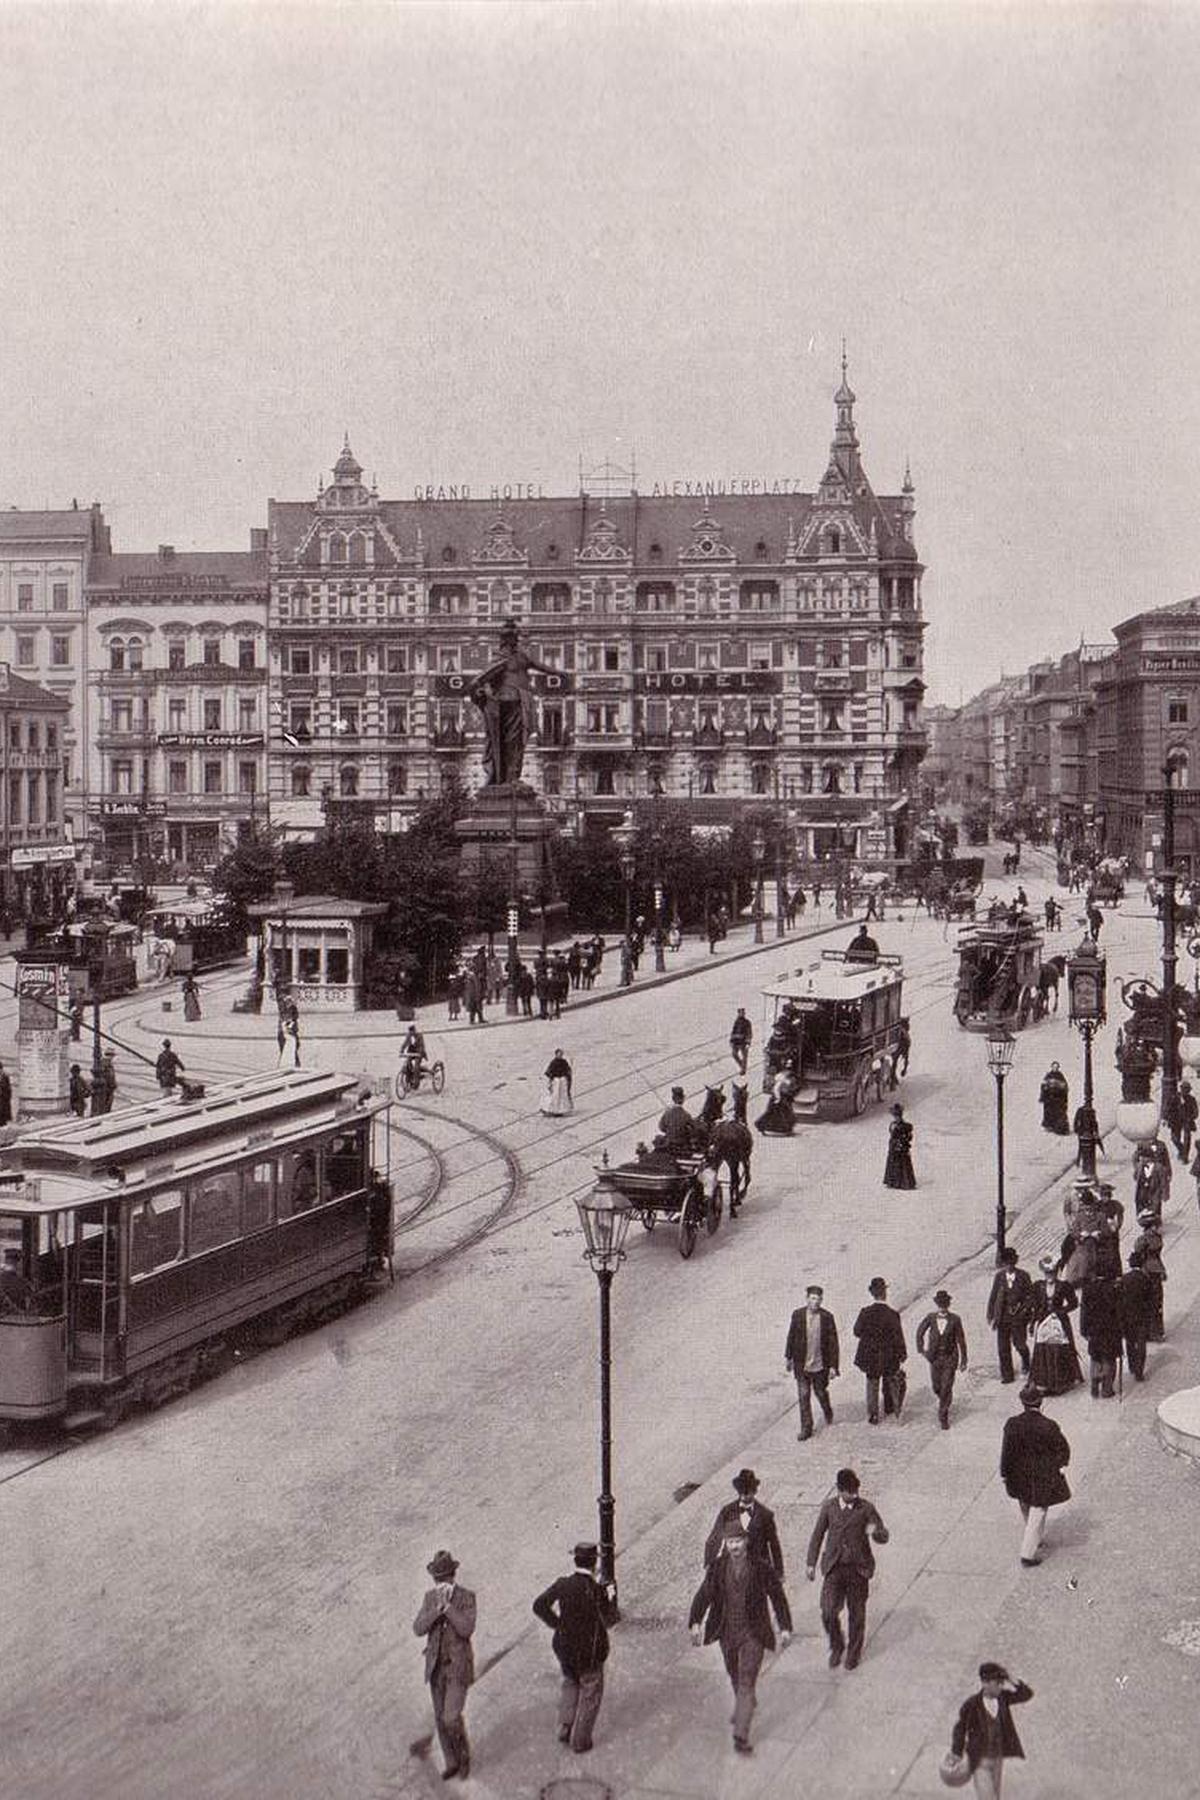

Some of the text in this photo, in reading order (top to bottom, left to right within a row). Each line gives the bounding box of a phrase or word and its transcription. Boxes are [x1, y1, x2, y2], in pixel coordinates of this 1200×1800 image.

[414, 483, 546, 501] GRAND HOTEL
[652, 479, 801, 497] ALEXANDERPLATZ
[645, 674, 756, 687] HOTEL
